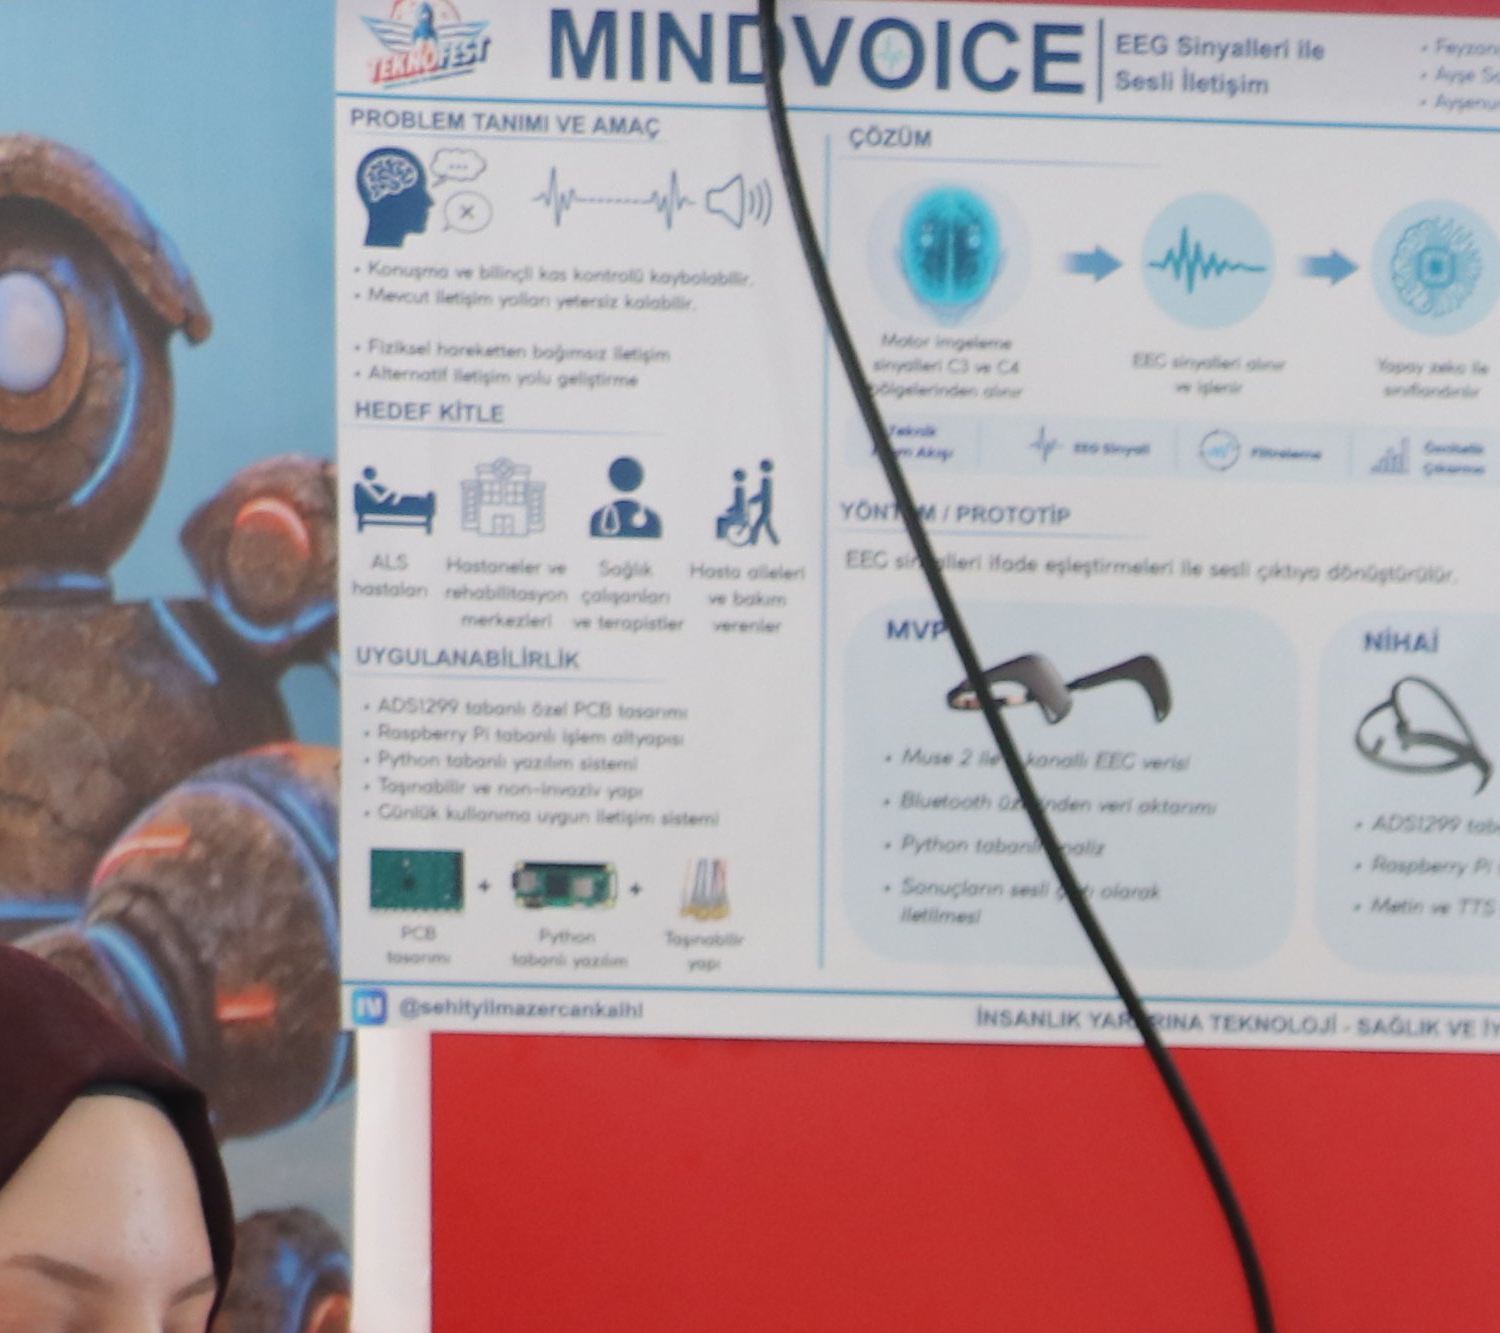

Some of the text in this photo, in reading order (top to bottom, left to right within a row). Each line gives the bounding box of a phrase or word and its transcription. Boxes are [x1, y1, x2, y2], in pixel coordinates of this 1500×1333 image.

[550, 8, 1085, 95] MINDVOICE
[1116, 33, 1325, 62] EEG Sinyalleri ile
[366, 36, 492, 84] TEKNOFEST
[1115, 69, 1269, 98] Sesli İletişim
[351, 108, 660, 140] PROBLEM TANIMI VE AMAÇ
[849, 125, 932, 149] ÇÖZÜM
[367, 260, 449, 281] Konuşma
[454, 267, 474, 281] ve
[478, 264, 533, 284] bilinçli
[538, 266, 567, 283] kas
[573, 268, 644, 285] kontrolü
[368, 286, 430, 304] Mevcut
[556, 294, 618, 310] yetersiz
[368, 337, 431, 356] Fiziksel
[436, 342, 527, 359] hareketten
[368, 365, 448, 383] Alternatif
[517, 370, 552, 387] yolu
[557, 372, 639, 390] geliştirme
[355, 401, 504, 424] HEDEF KİTLE
[840, 498, 1071, 525] YÖNTM PROTOTİP
[371, 553, 409, 572] ALS
[446, 558, 567, 576] Hastaneler ve
[690, 563, 741, 580] Hasta
[989, 554, 1038, 574] ifade
[1044, 558, 1173, 578] eşleştirmeleri
[1181, 560, 1203, 578] ile
[1209, 561, 1250, 579] sesli
[445, 585, 568, 603] rehabilitasyon
[708, 593, 727, 606] ve
[461, 613, 552, 629] merkezleri
[573, 616, 684, 633] ve terapistler
[714, 620, 781, 634] verenler
[888, 618, 949, 640] MVP
[1364, 629, 1438, 653] NİHAİ
[356, 647, 579, 669] UYGULANABİLİRLİK
[377, 696, 460, 715] ADS1299
[531, 701, 568, 718] özel
[573, 700, 612, 719] PCB
[377, 723, 467, 744] Raspberry
[472, 724, 490, 741] Pi
[377, 749, 440, 769] Python
[579, 757, 638, 772] sistemi
[902, 747, 953, 766] Muse
[960, 748, 973, 767] 2
[472, 783, 492, 796] ve
[900, 790, 992, 811] Bluetooth
[377, 803, 440, 821] Günlük
[537, 811, 590, 827] uygun
[660, 811, 719, 828] sistemi
[976, 1007, 1080, 1029] İNSANLIK
[1091, 1010, 1203, 1030] YARRINA
[1210, 1013, 1337, 1035] TEKNOLOJİ
[1357, 1015, 1439, 1037] SAĞLIK
[1447, 1019, 1474, 1039] VE
